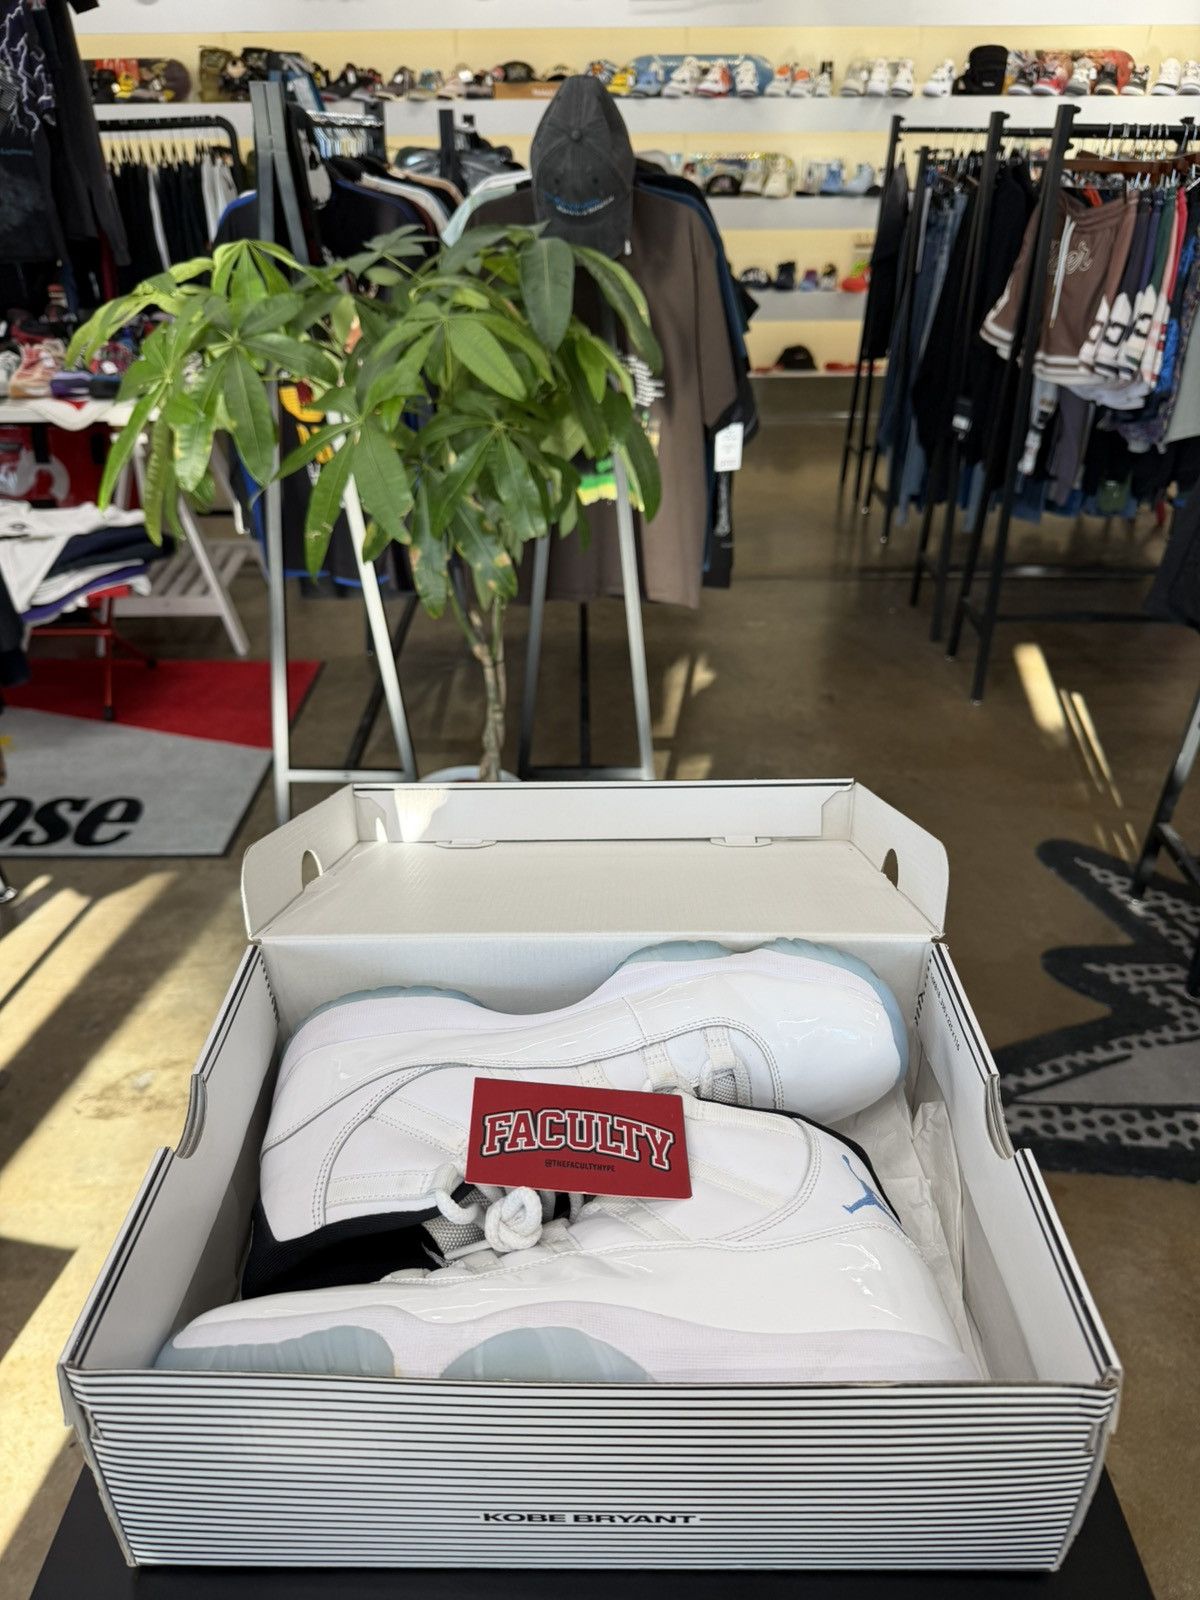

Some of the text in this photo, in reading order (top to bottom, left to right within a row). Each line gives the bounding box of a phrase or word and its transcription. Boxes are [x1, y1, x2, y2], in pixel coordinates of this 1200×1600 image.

[481, 1108, 675, 1171] FACULTY
[544, 1159, 616, 1172] @THEFACULTYHYPE
[483, 1513, 696, 1524] KOBE BRYANT
